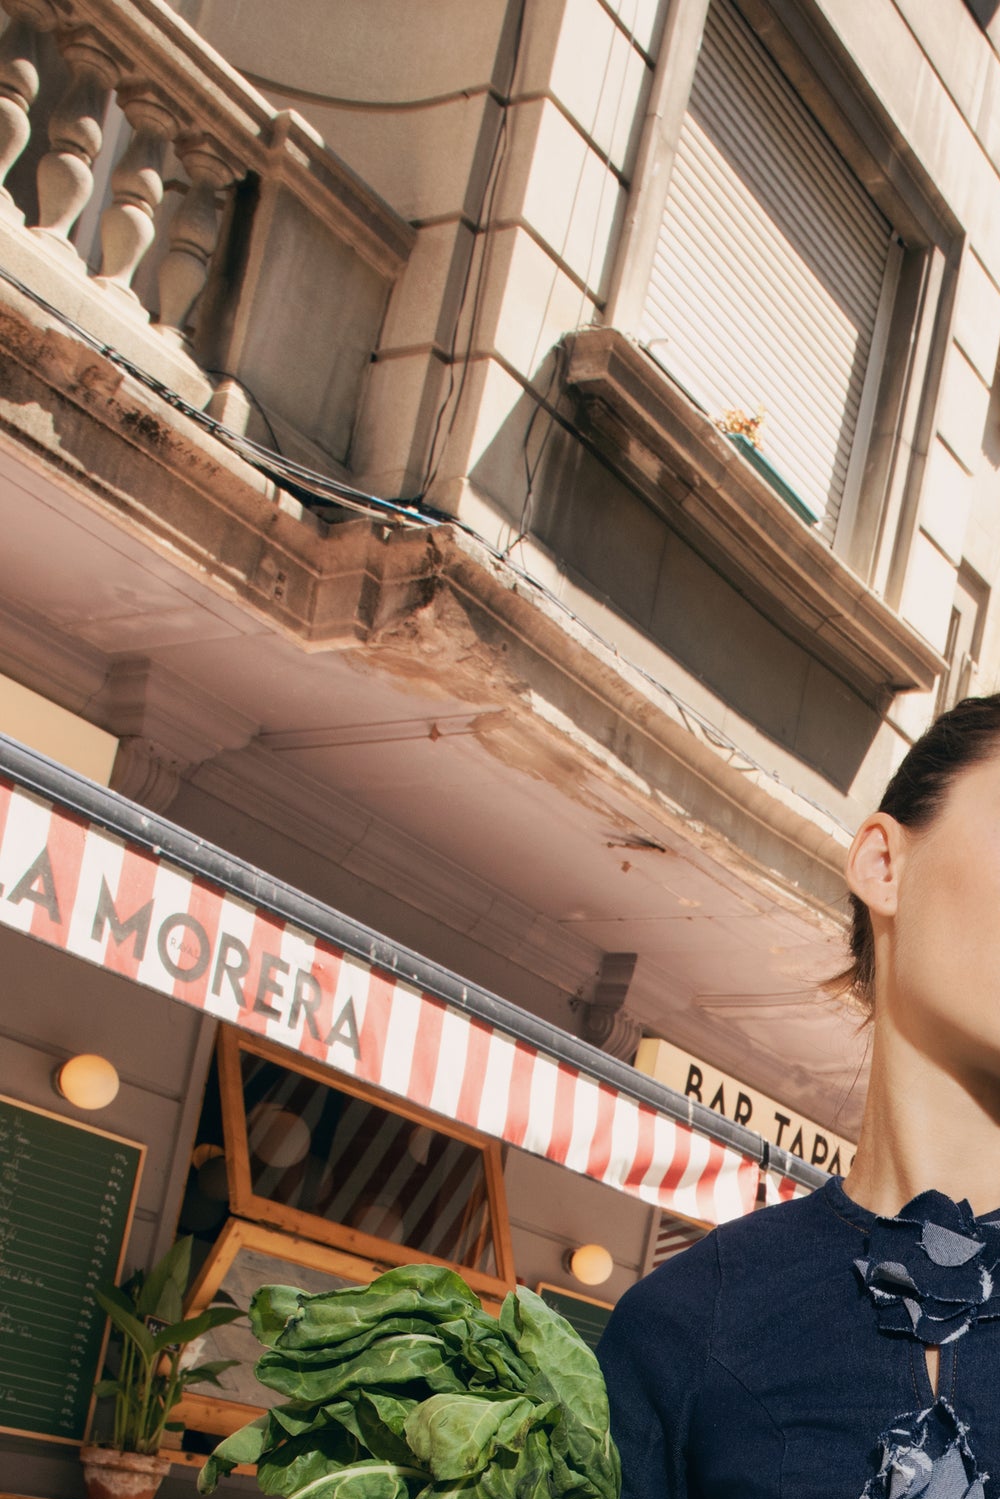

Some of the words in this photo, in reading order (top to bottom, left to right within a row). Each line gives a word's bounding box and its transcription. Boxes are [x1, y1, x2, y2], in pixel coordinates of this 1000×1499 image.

[0, 846, 63, 925] A
[90, 872, 362, 1061] MORERA
[684, 1063, 753, 1127] BAR
[774, 1111, 856, 1176] TAPA
